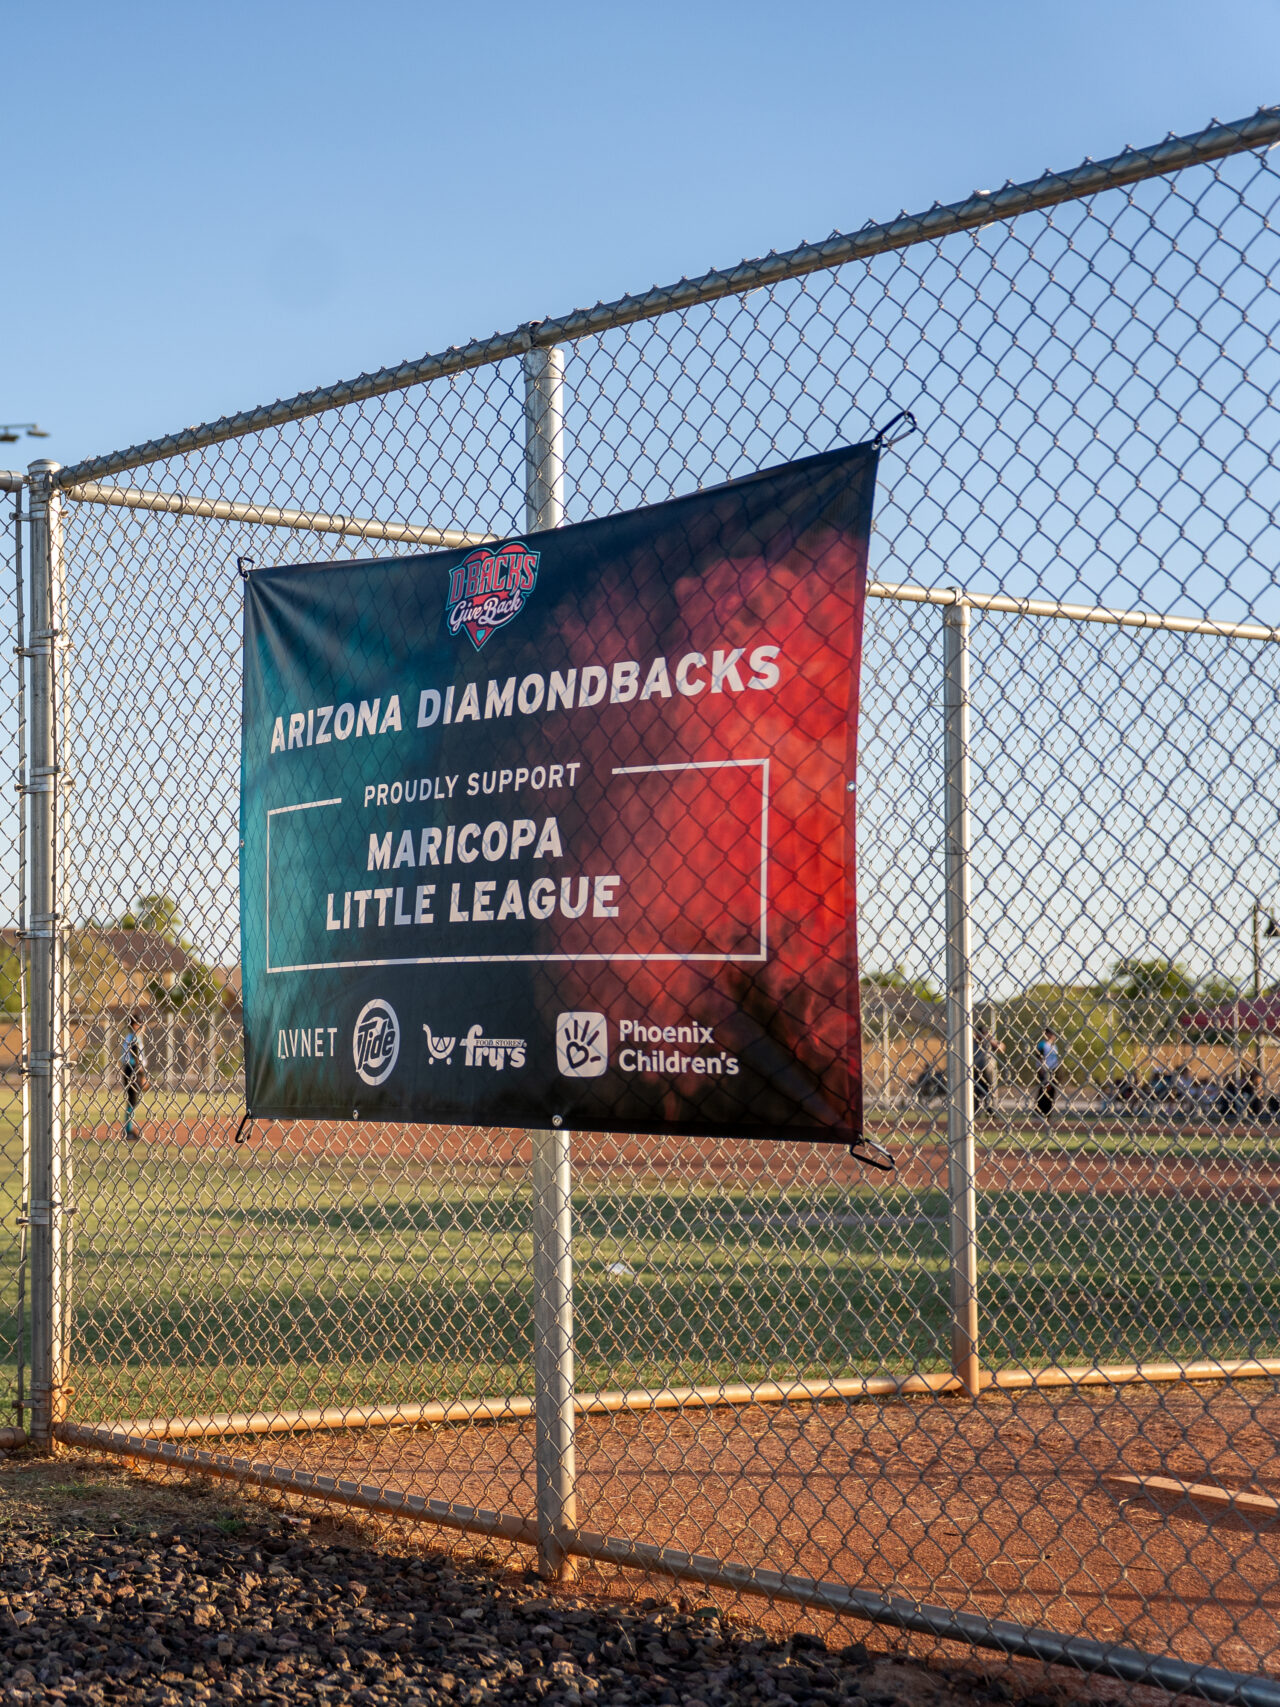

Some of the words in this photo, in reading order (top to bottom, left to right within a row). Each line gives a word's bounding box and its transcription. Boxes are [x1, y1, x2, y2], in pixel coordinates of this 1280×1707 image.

[450, 600, 482, 631] Give
[478, 589, 522, 625] Back
[270, 695, 401, 754] ARIZONA
[417, 645, 782, 729] DIAMONDBACKS
[364, 775, 460, 808] PROUDLY
[467, 762, 581, 796] SUPPORT
[367, 816, 563, 872] MARICOPA
[326, 884, 435, 931] LITTLE
[450, 875, 621, 923] LEAGUE
[277, 1027, 338, 1059] AVNET
[354, 1016, 396, 1073] Tide
[475, 1037, 494, 1047] FOOD
[495, 1037, 523, 1047] STORES
[619, 1019, 715, 1045] Phoenix
[619, 1051, 740, 1076] Children's
